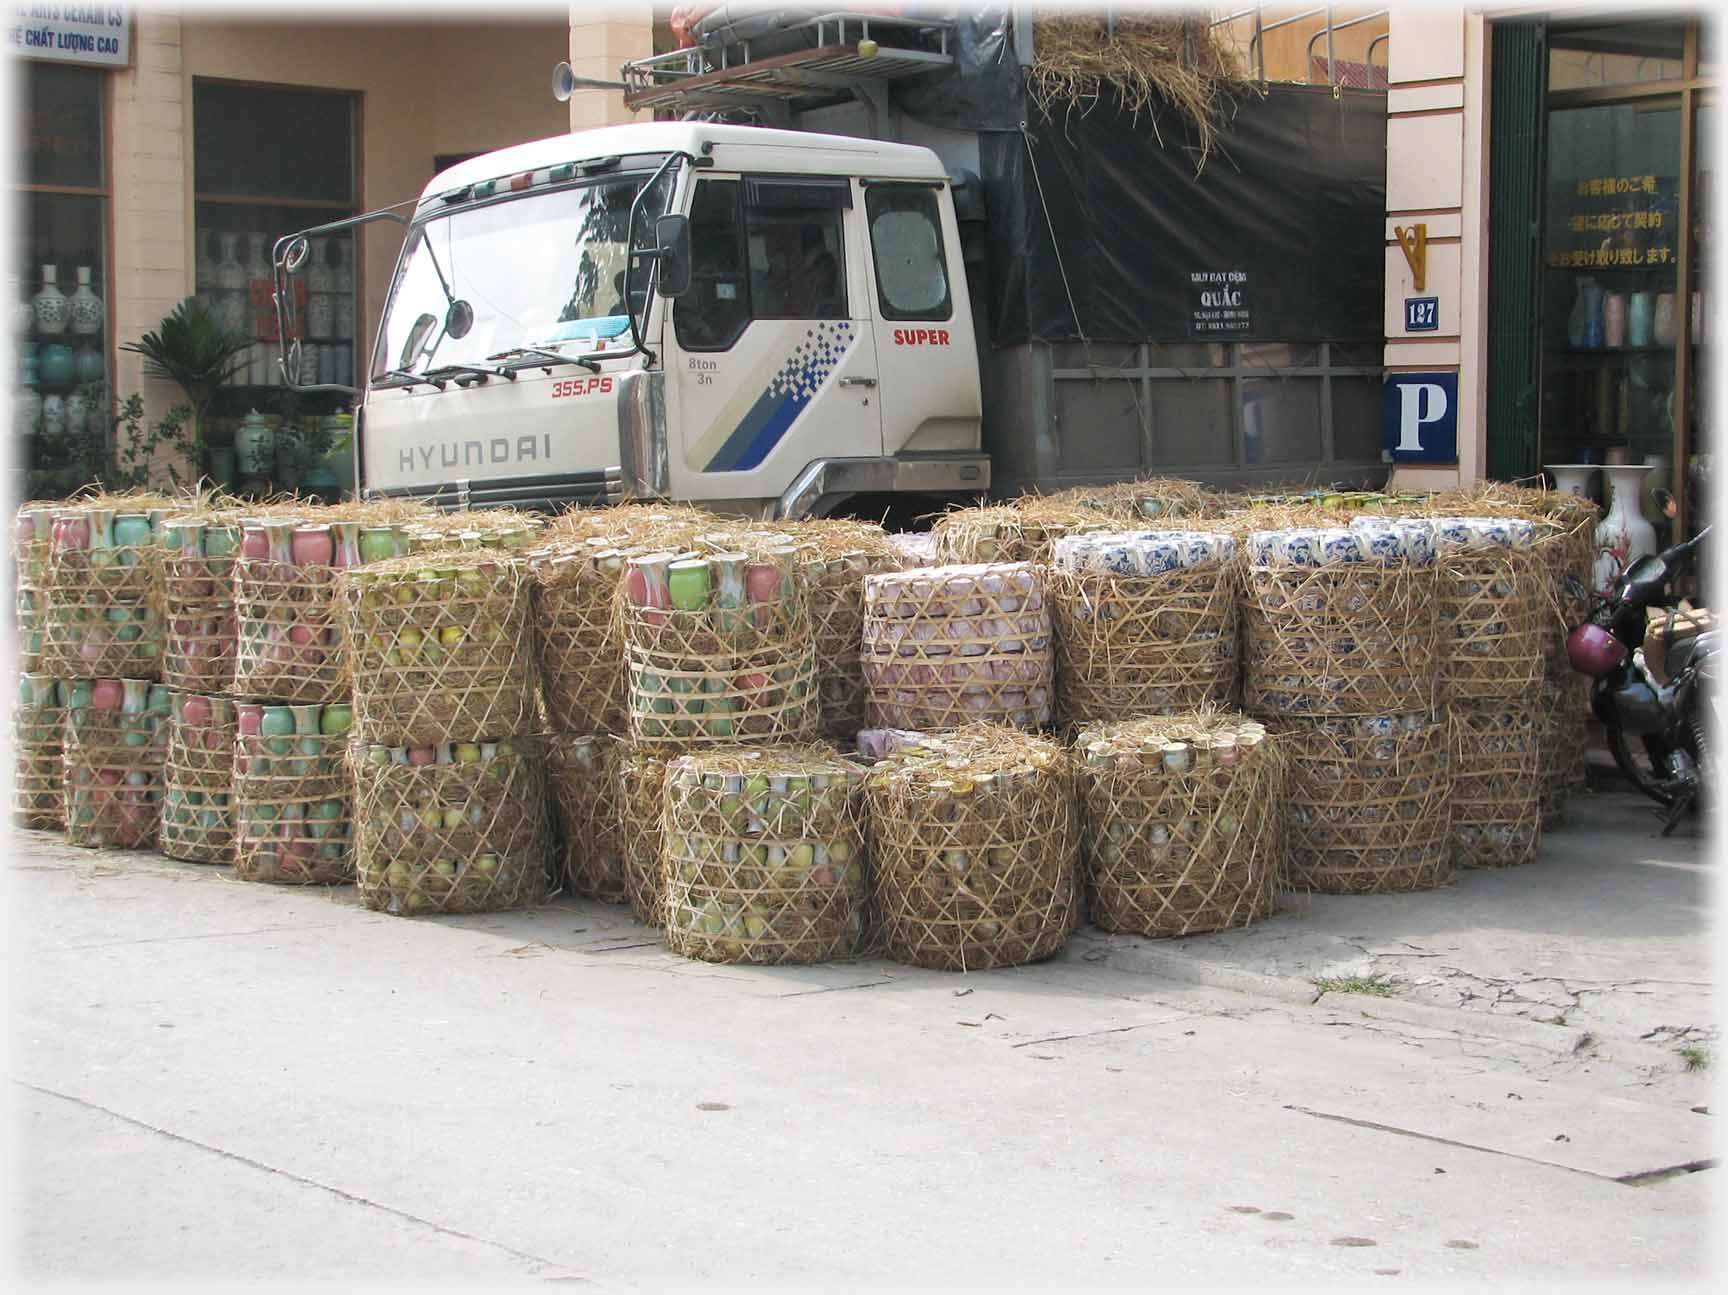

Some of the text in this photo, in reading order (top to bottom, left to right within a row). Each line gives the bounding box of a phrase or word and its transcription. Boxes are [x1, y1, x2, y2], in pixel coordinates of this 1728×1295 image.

[25, 26, 55, 48] CHẤT
[97, 37, 119, 54] CAO
[1409, 302, 1435, 324] 127
[894, 329, 950, 346] SUPER
[688, 357, 717, 370] 8ton
[552, 377, 613, 399] 355.PS
[697, 374, 713, 385] 3n
[1395, 383, 1448, 451] P
[399, 433, 550, 473] HYUNDAI
